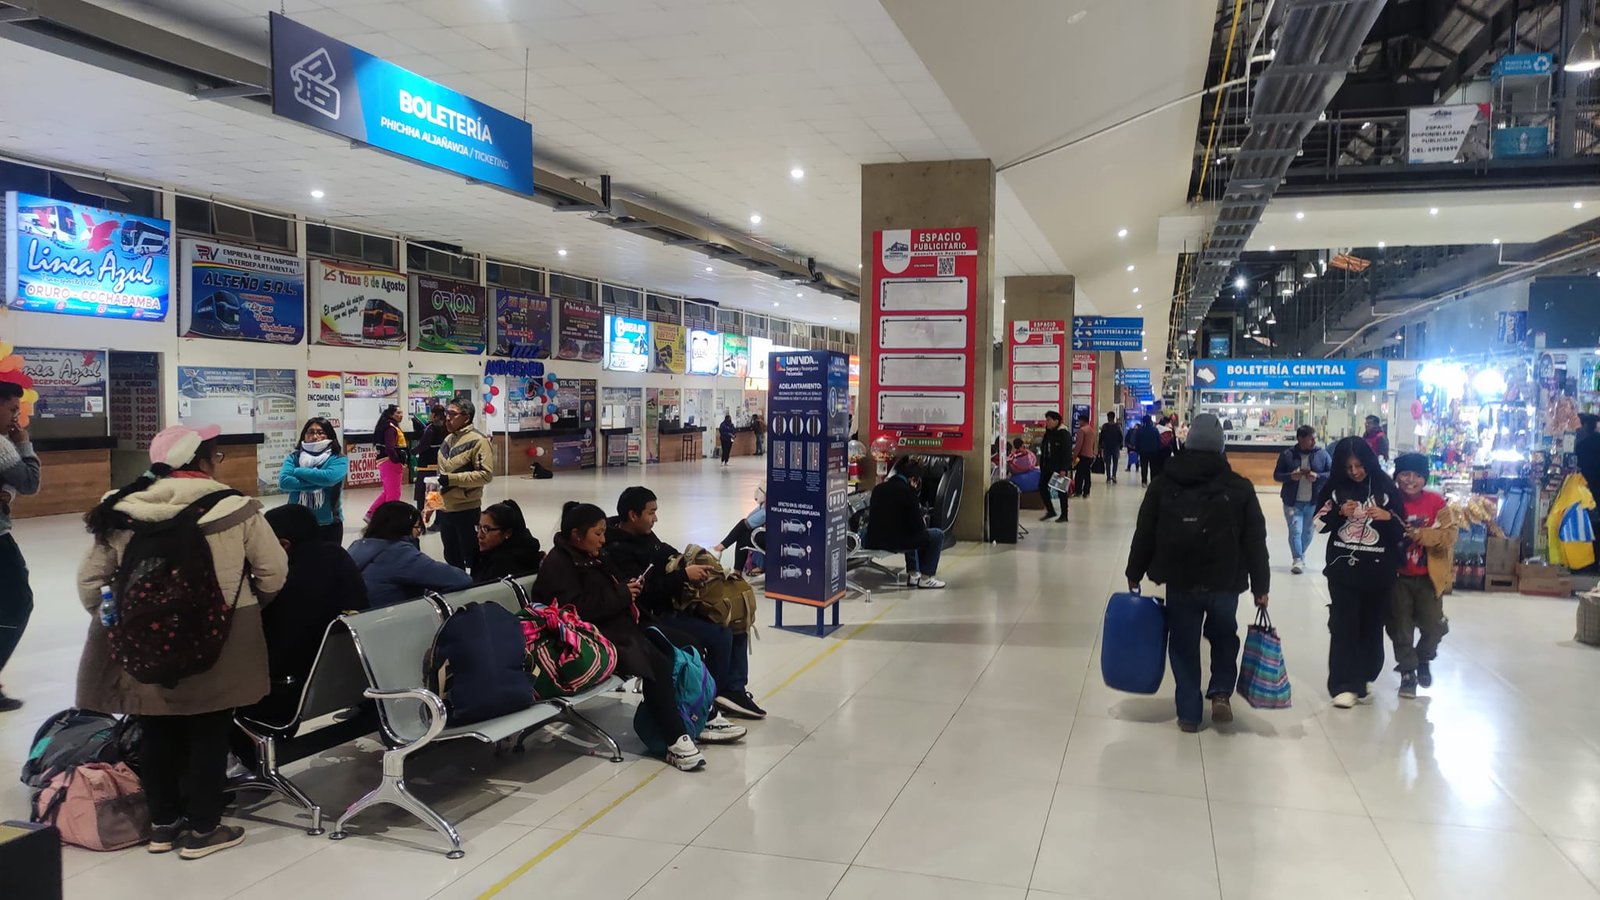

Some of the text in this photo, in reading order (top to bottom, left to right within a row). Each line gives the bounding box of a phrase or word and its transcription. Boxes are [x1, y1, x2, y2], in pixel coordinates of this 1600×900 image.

[399, 88, 493, 145] BOLETERÍA
[380, 116, 421, 139] PHICHHA
[474, 149, 509, 170] TICKETING
[919, 231, 962, 242] ESPACIO
[913, 241, 967, 251] PUBLICITARIO
[222, 248, 300, 268] EMPRESA DE TRANSPORTE
[227, 257, 296, 275] INTERDEPARTAMENTAL
[97, 249, 154, 294] Azul
[202, 271, 260, 292] ALTEÑO
[338, 270, 362, 286] Trans
[370, 276, 380, 289] de
[381, 277, 406, 293] Agosto
[26, 283, 71, 298] ORURO
[80, 289, 162, 310] COCHABAMBA
[431, 289, 476, 321] ORION
[785, 355, 814, 365] UNIVIDA
[1226, 362, 1346, 375] BOLETERÍA CENTRAL
[778, 382, 823, 390] ADELANTAMIENTO:
[307, 393, 340, 402] ENCOMIENDAS
[350, 471, 375, 480] ORURO
[782, 507, 801, 515] VELOCIDAD
[801, 509, 821, 517] EMPLEADA
